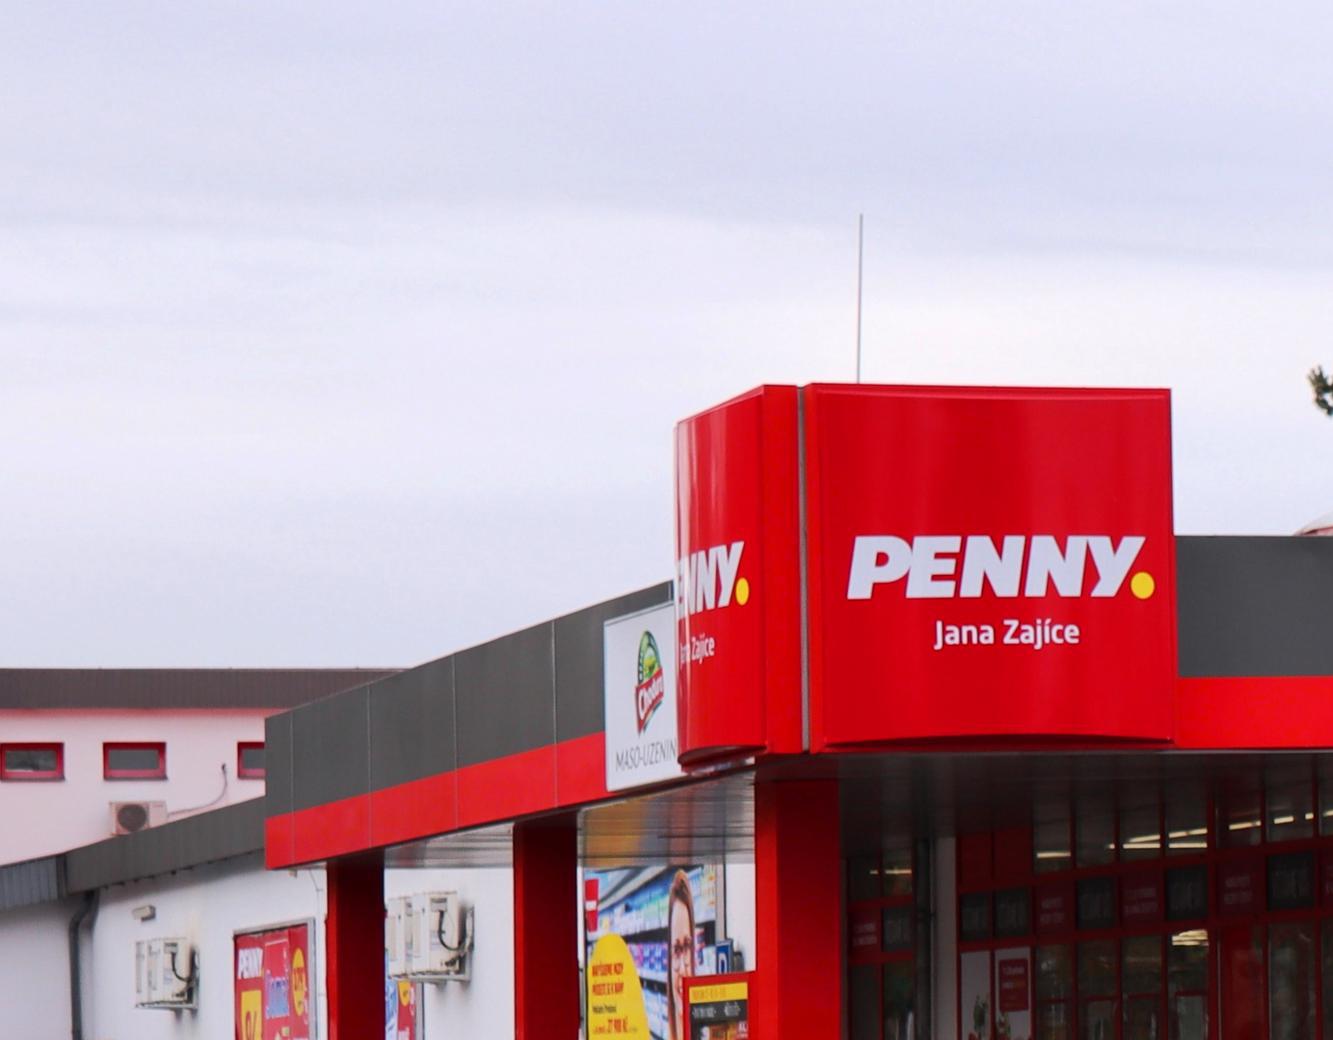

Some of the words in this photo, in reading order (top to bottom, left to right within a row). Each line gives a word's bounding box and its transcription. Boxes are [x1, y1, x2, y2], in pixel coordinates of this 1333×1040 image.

[847, 535, 1155, 600] PENNY.
[934, 620, 994, 650] Jana
[1003, 618, 1080, 650] Zajíce
[616, 739, 676, 772] MASO-UZENIN
